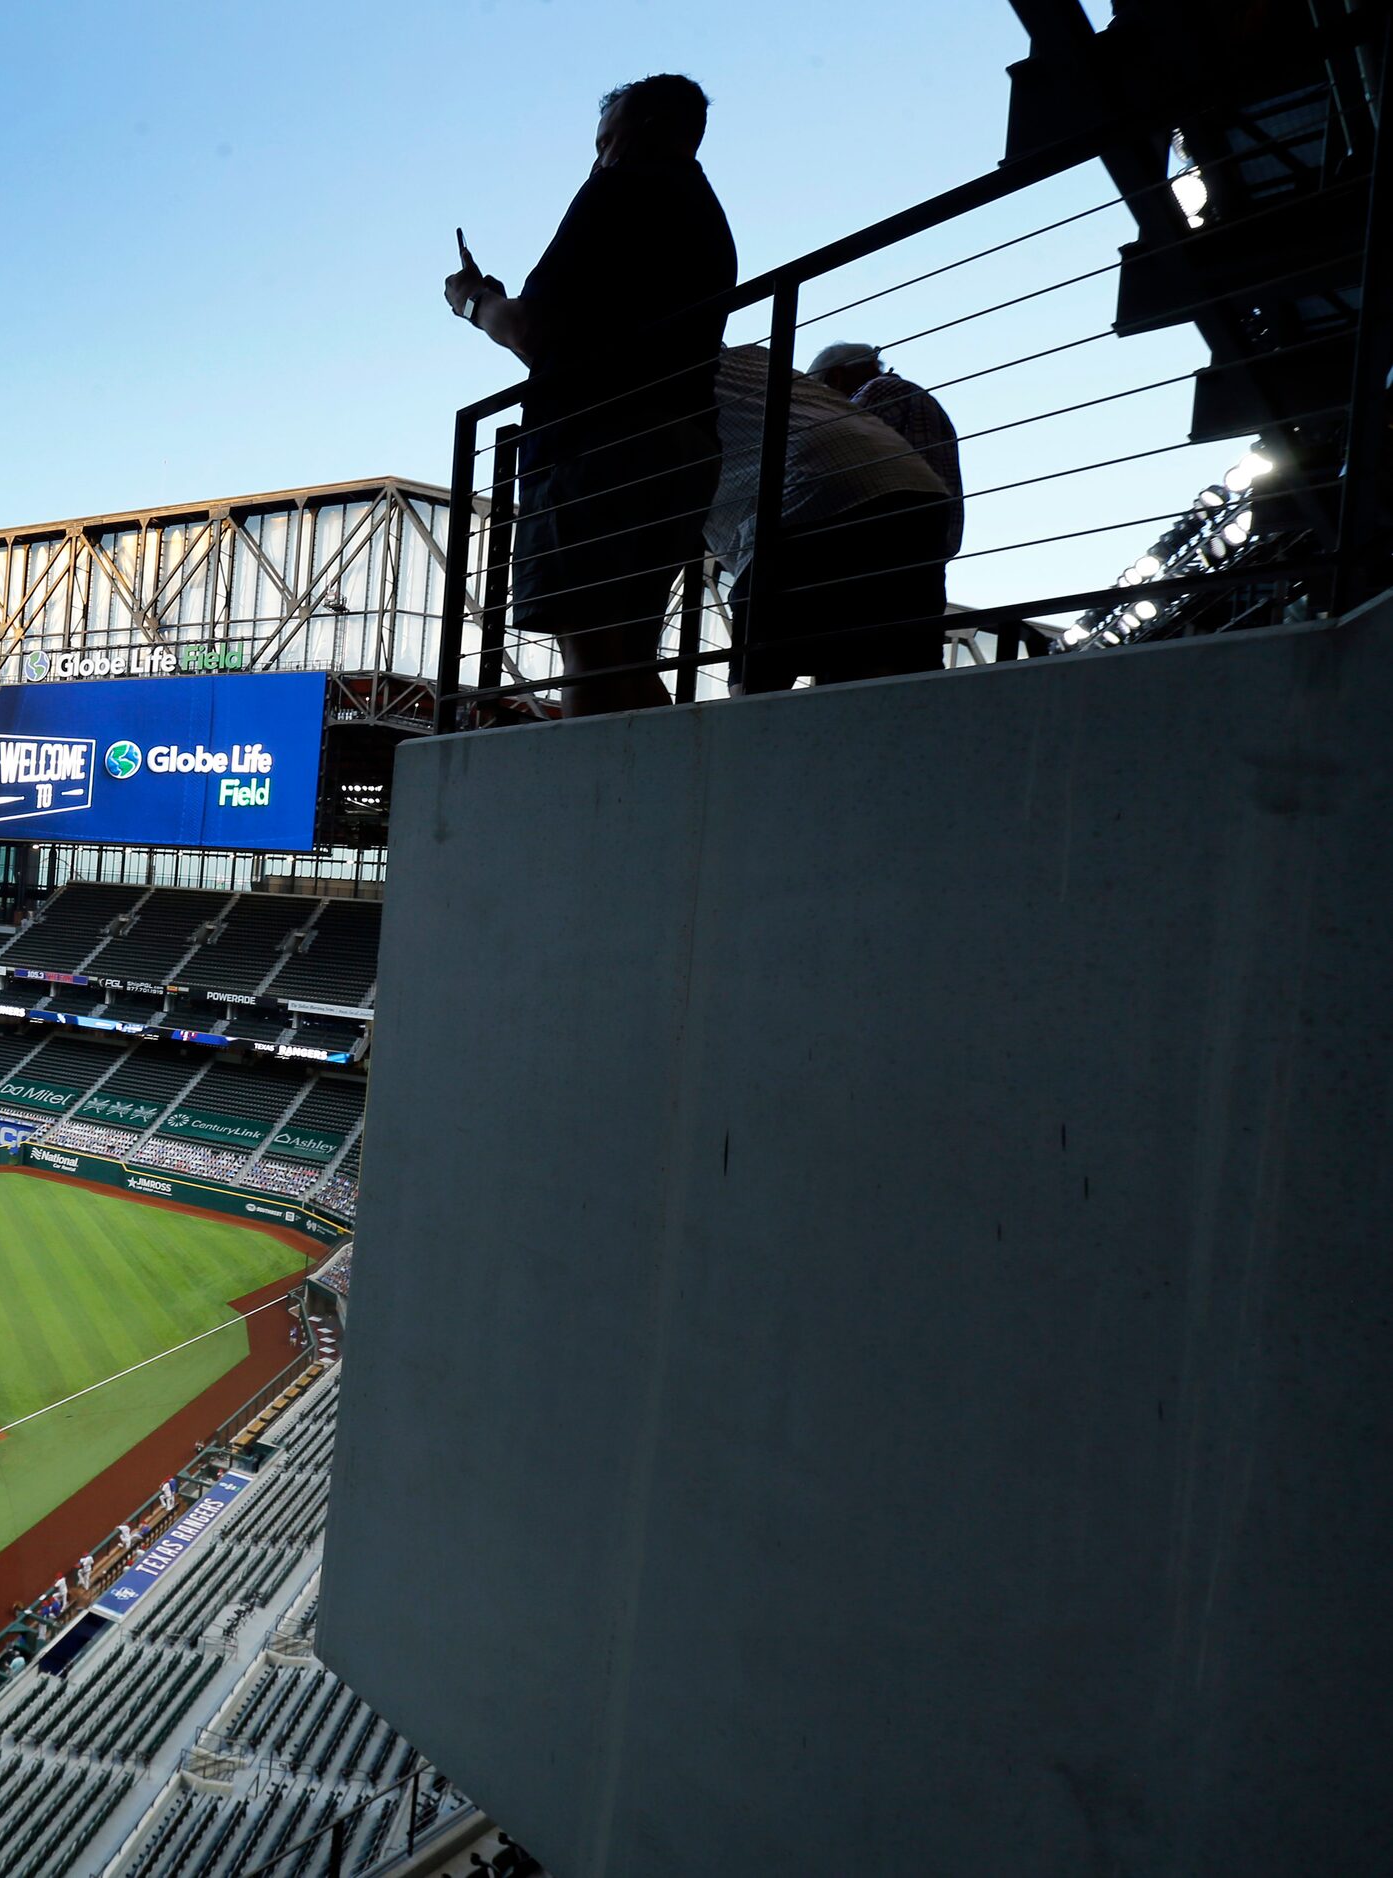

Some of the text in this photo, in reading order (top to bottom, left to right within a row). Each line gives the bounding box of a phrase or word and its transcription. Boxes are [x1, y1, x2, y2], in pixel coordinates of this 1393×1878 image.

[56, 642, 243, 678] Globe Life Field
[147, 744, 273, 774] Globe Life
[36, 783, 52, 808] TO
[218, 777, 270, 807] Field
[27, 970, 44, 979] 105.3
[105, 979, 123, 988] PGL
[207, 991, 256, 1005] POWERADE
[254, 1043, 328, 1060] TEXAS RANGERS
[22, 1087, 72, 1106] Mitel
[191, 1119, 261, 1139] CenturyLink
[289, 1136, 337, 1154] Ashley
[41, 1150, 79, 1167] National
[136, 1497, 224, 1576] TEXAS RANGERS
